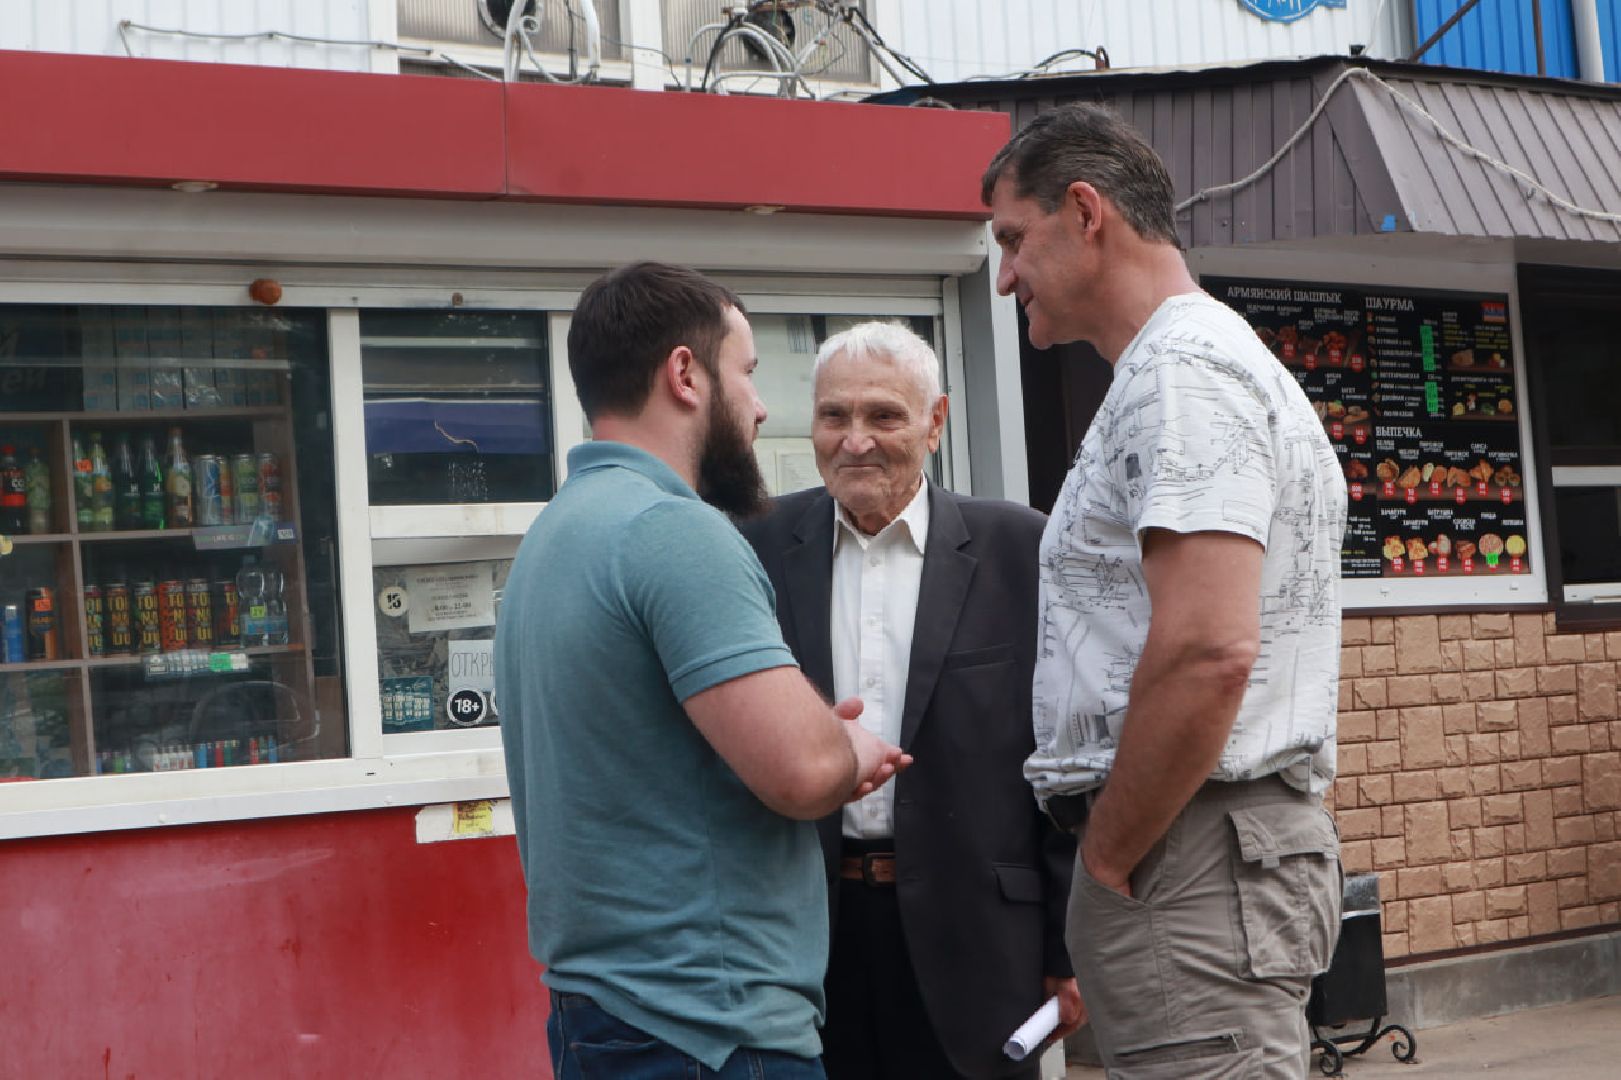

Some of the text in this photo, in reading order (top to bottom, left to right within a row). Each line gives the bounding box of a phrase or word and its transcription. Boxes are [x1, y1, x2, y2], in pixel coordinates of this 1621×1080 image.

[1227, 286, 1291, 301] АРМЯНСКИЙ
[1365, 297, 1414, 311] ШАУРМА
[1375, 426, 1422, 438] ВЫПЕЧКА
[454, 698, 480, 714] 18+
